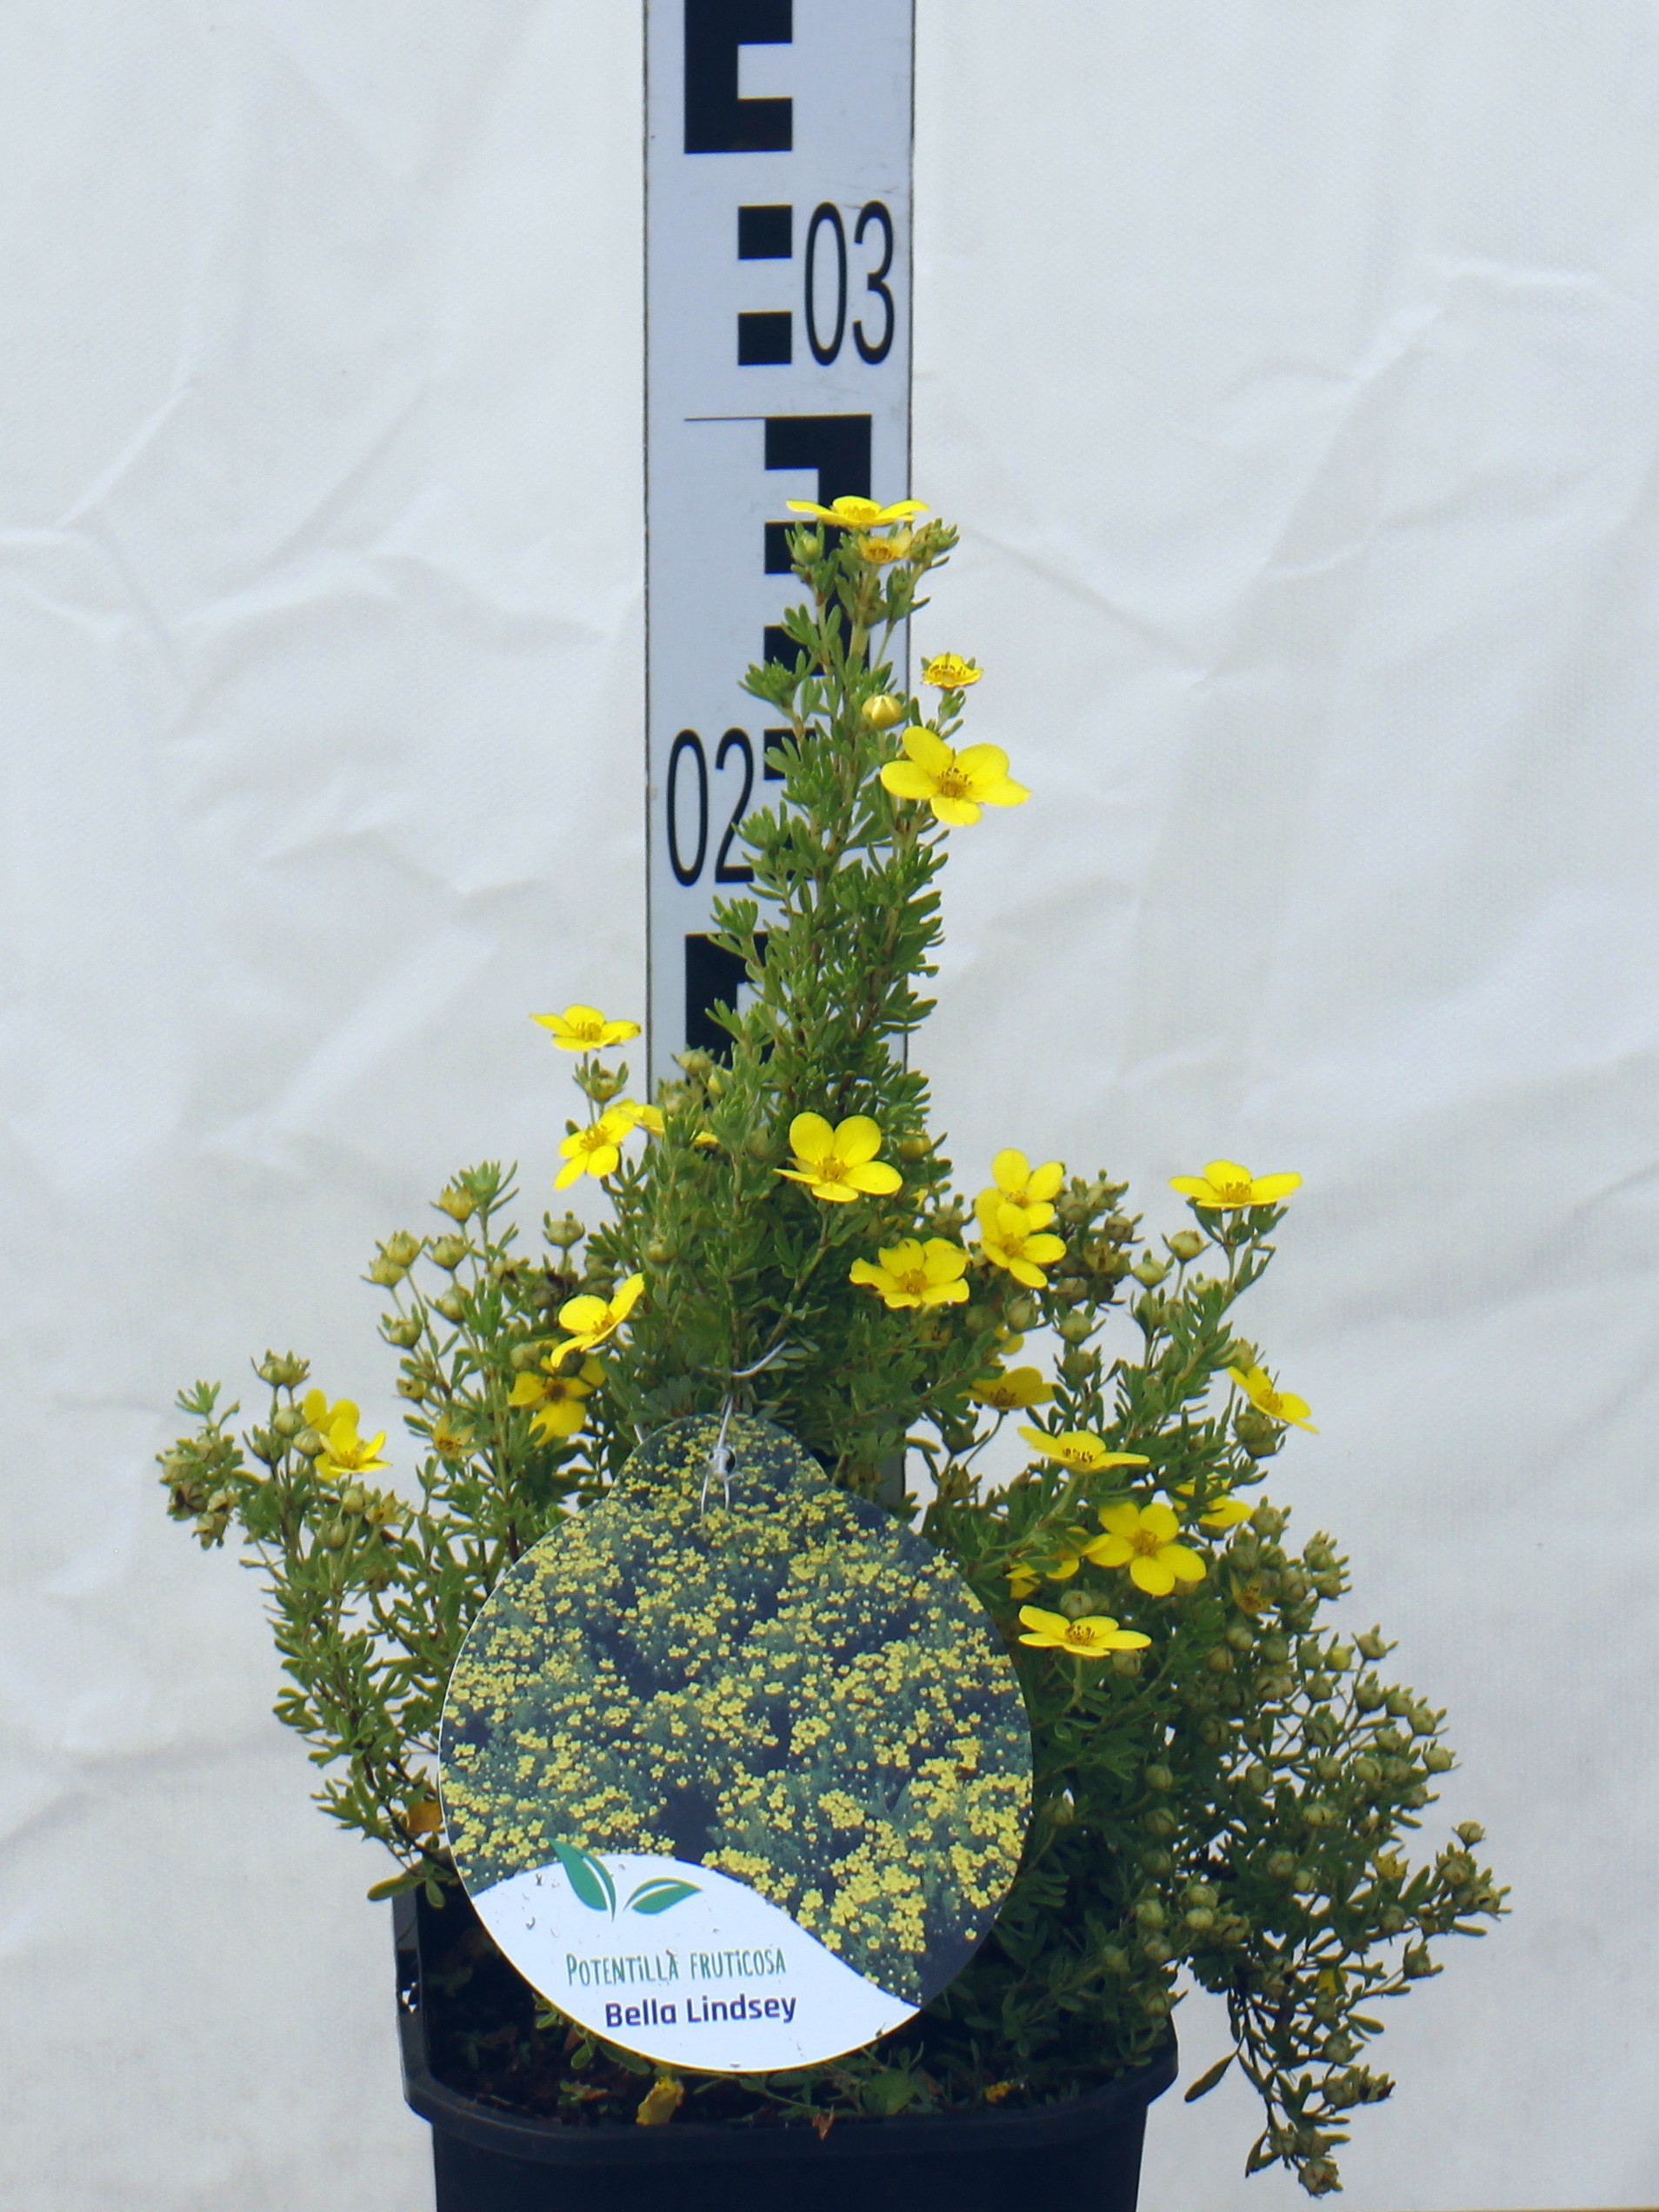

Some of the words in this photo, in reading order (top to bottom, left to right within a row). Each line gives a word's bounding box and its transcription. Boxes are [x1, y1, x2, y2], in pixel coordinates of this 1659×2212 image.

[805, 201, 896, 366] 03
[667, 728, 756, 886] 02
[605, 1998, 677, 2028] Bella
[686, 1993, 797, 2023] Lindsey
